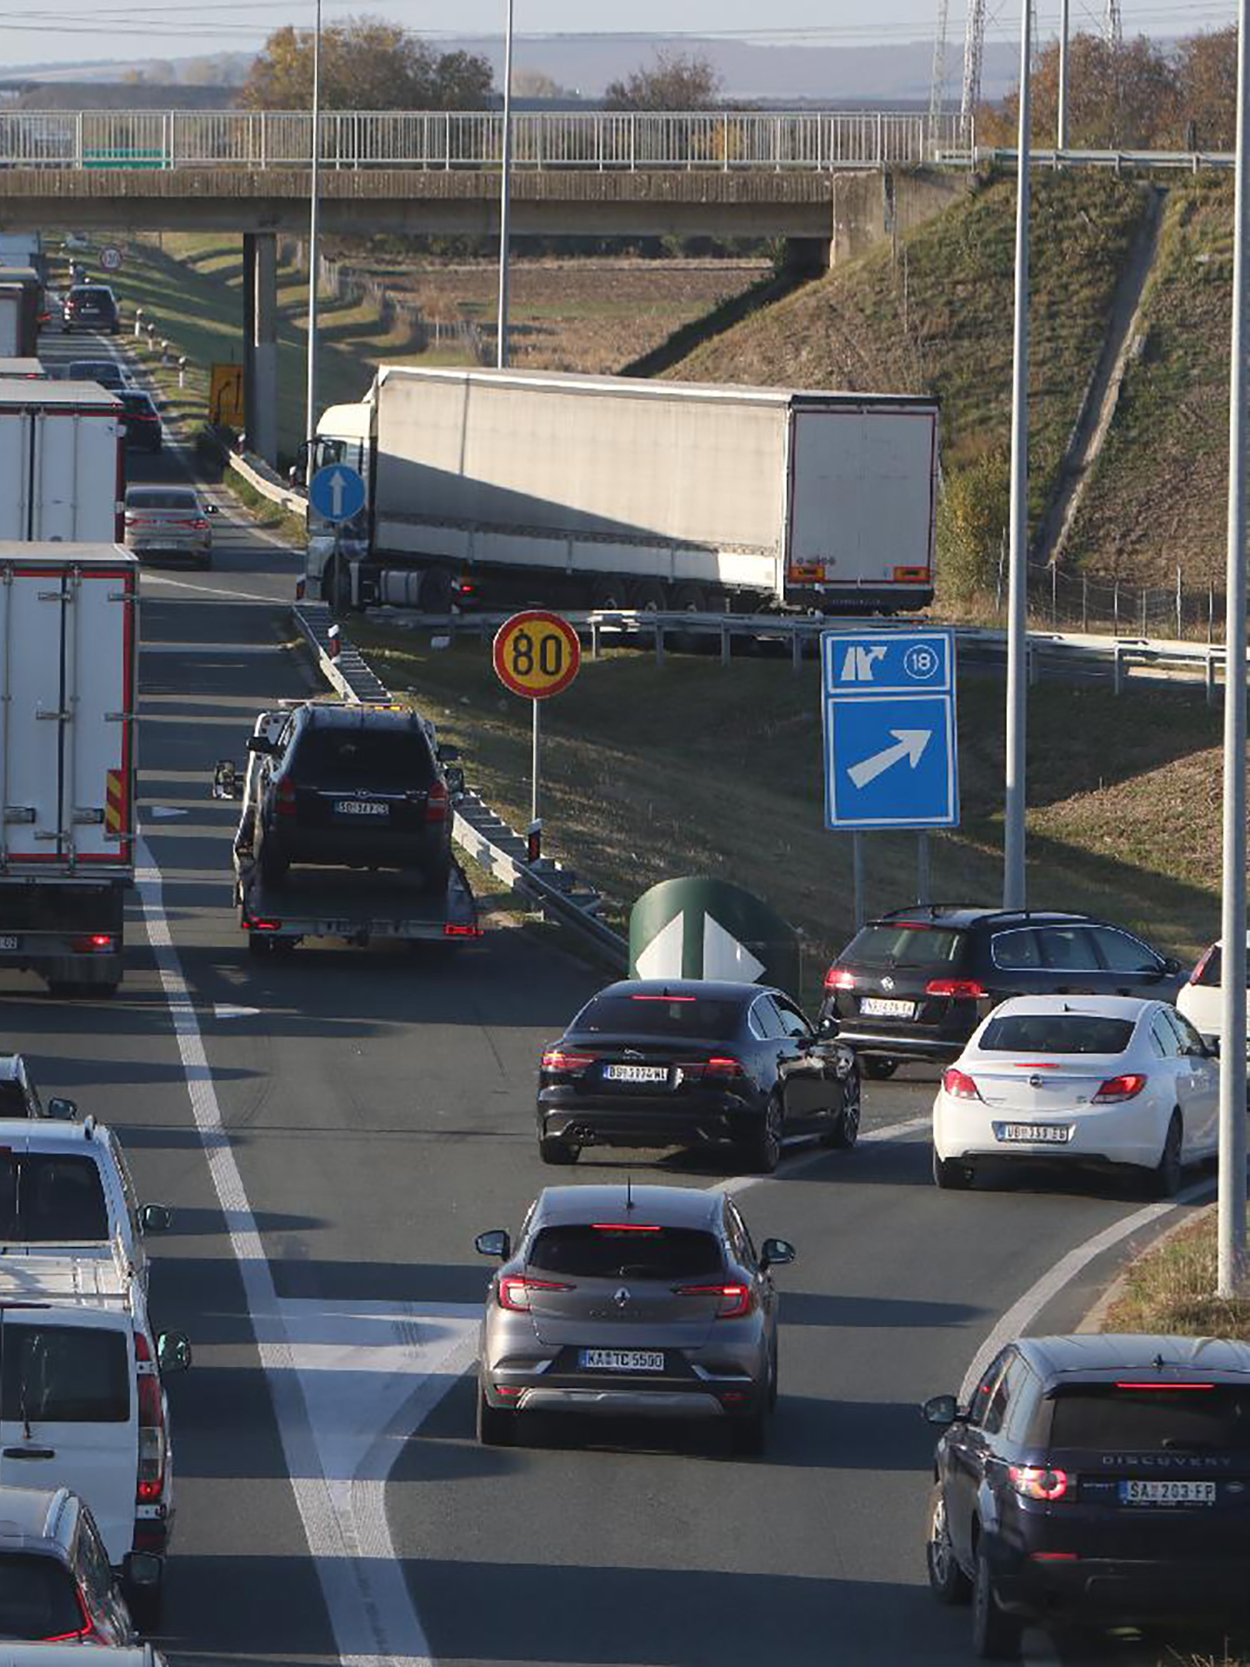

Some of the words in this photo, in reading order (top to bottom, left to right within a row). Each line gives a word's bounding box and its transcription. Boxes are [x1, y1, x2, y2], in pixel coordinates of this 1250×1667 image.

[513, 633, 563, 676] 80
[912, 652, 931, 671] 18
[613, 1353, 629, 1366] TC
[1102, 1456, 1231, 1467] DISCOVERY
